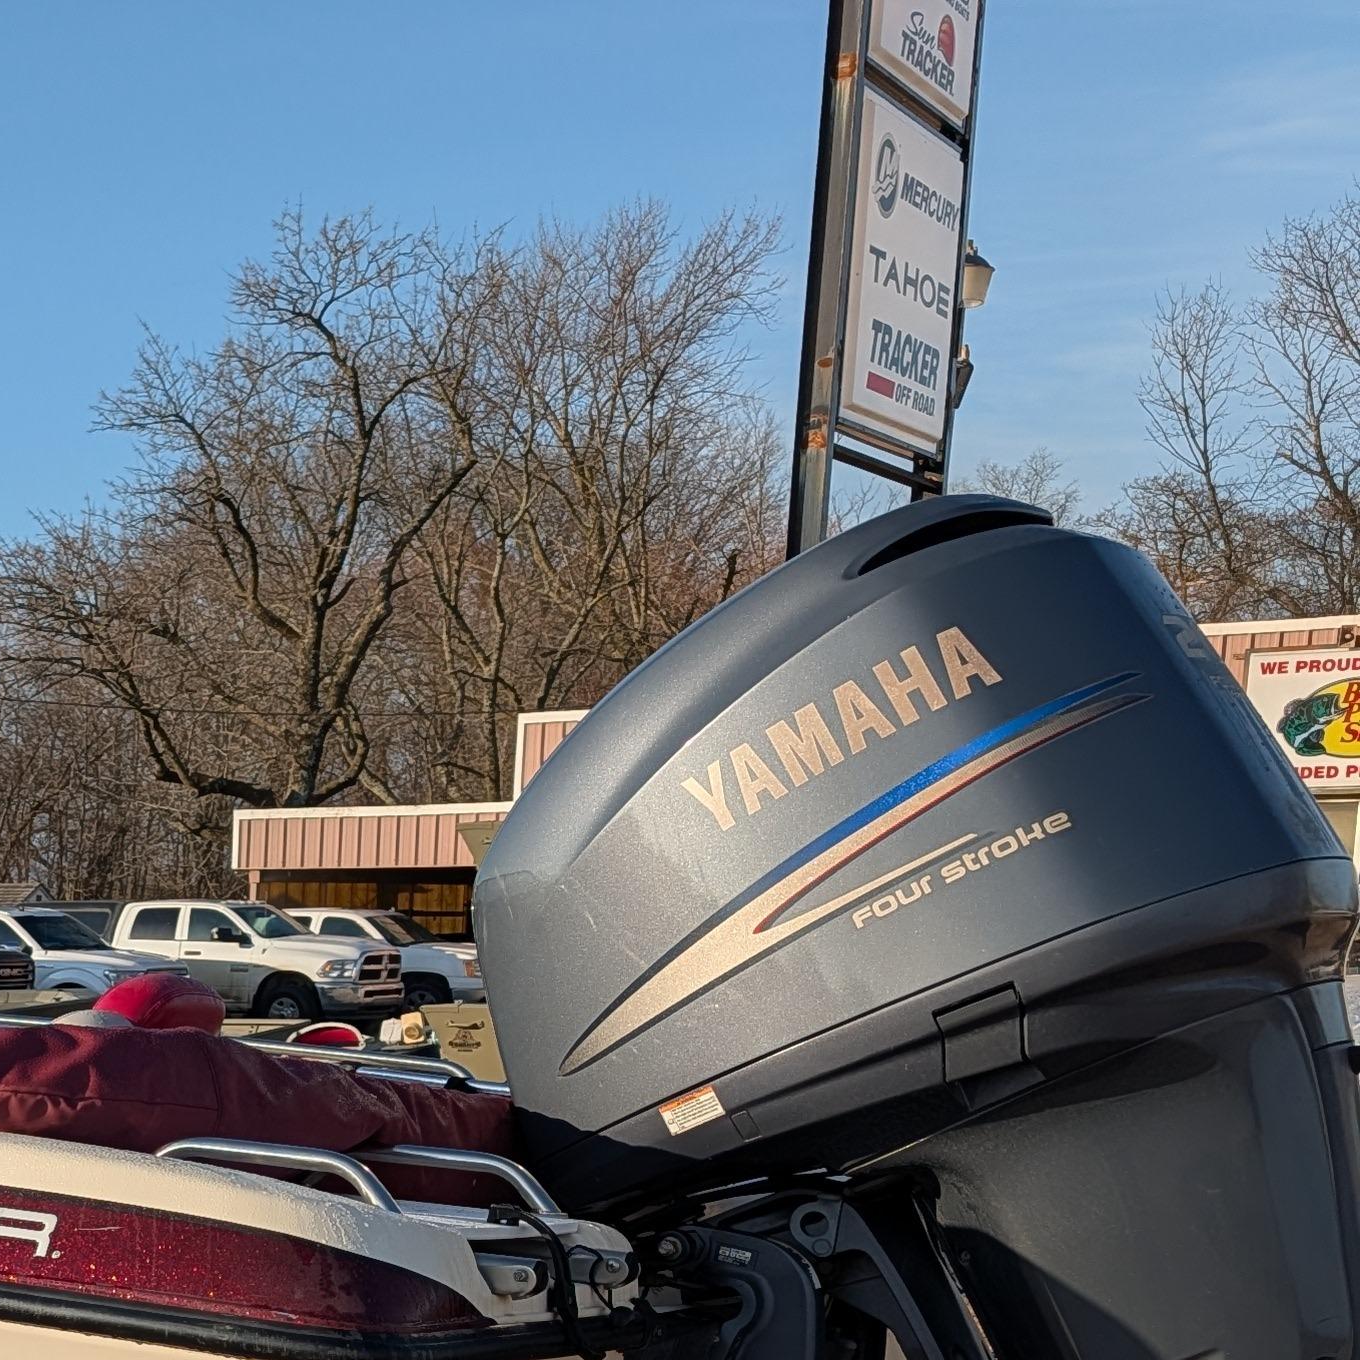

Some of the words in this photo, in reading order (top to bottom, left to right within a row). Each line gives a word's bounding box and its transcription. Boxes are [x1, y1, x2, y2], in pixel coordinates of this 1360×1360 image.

[906, 11, 937, 50] Sun
[900, 30, 955, 97] TRACKER
[900, 172, 960, 231] MERCURY
[869, 244, 951, 320] TAHOE
[870, 318, 940, 391] TRACKER
[895, 383, 912, 407] OFF
[911, 390, 935, 416] ROAD
[1260, 660, 1289, 675] WE
[681, 625, 1005, 833] YAMAHA
